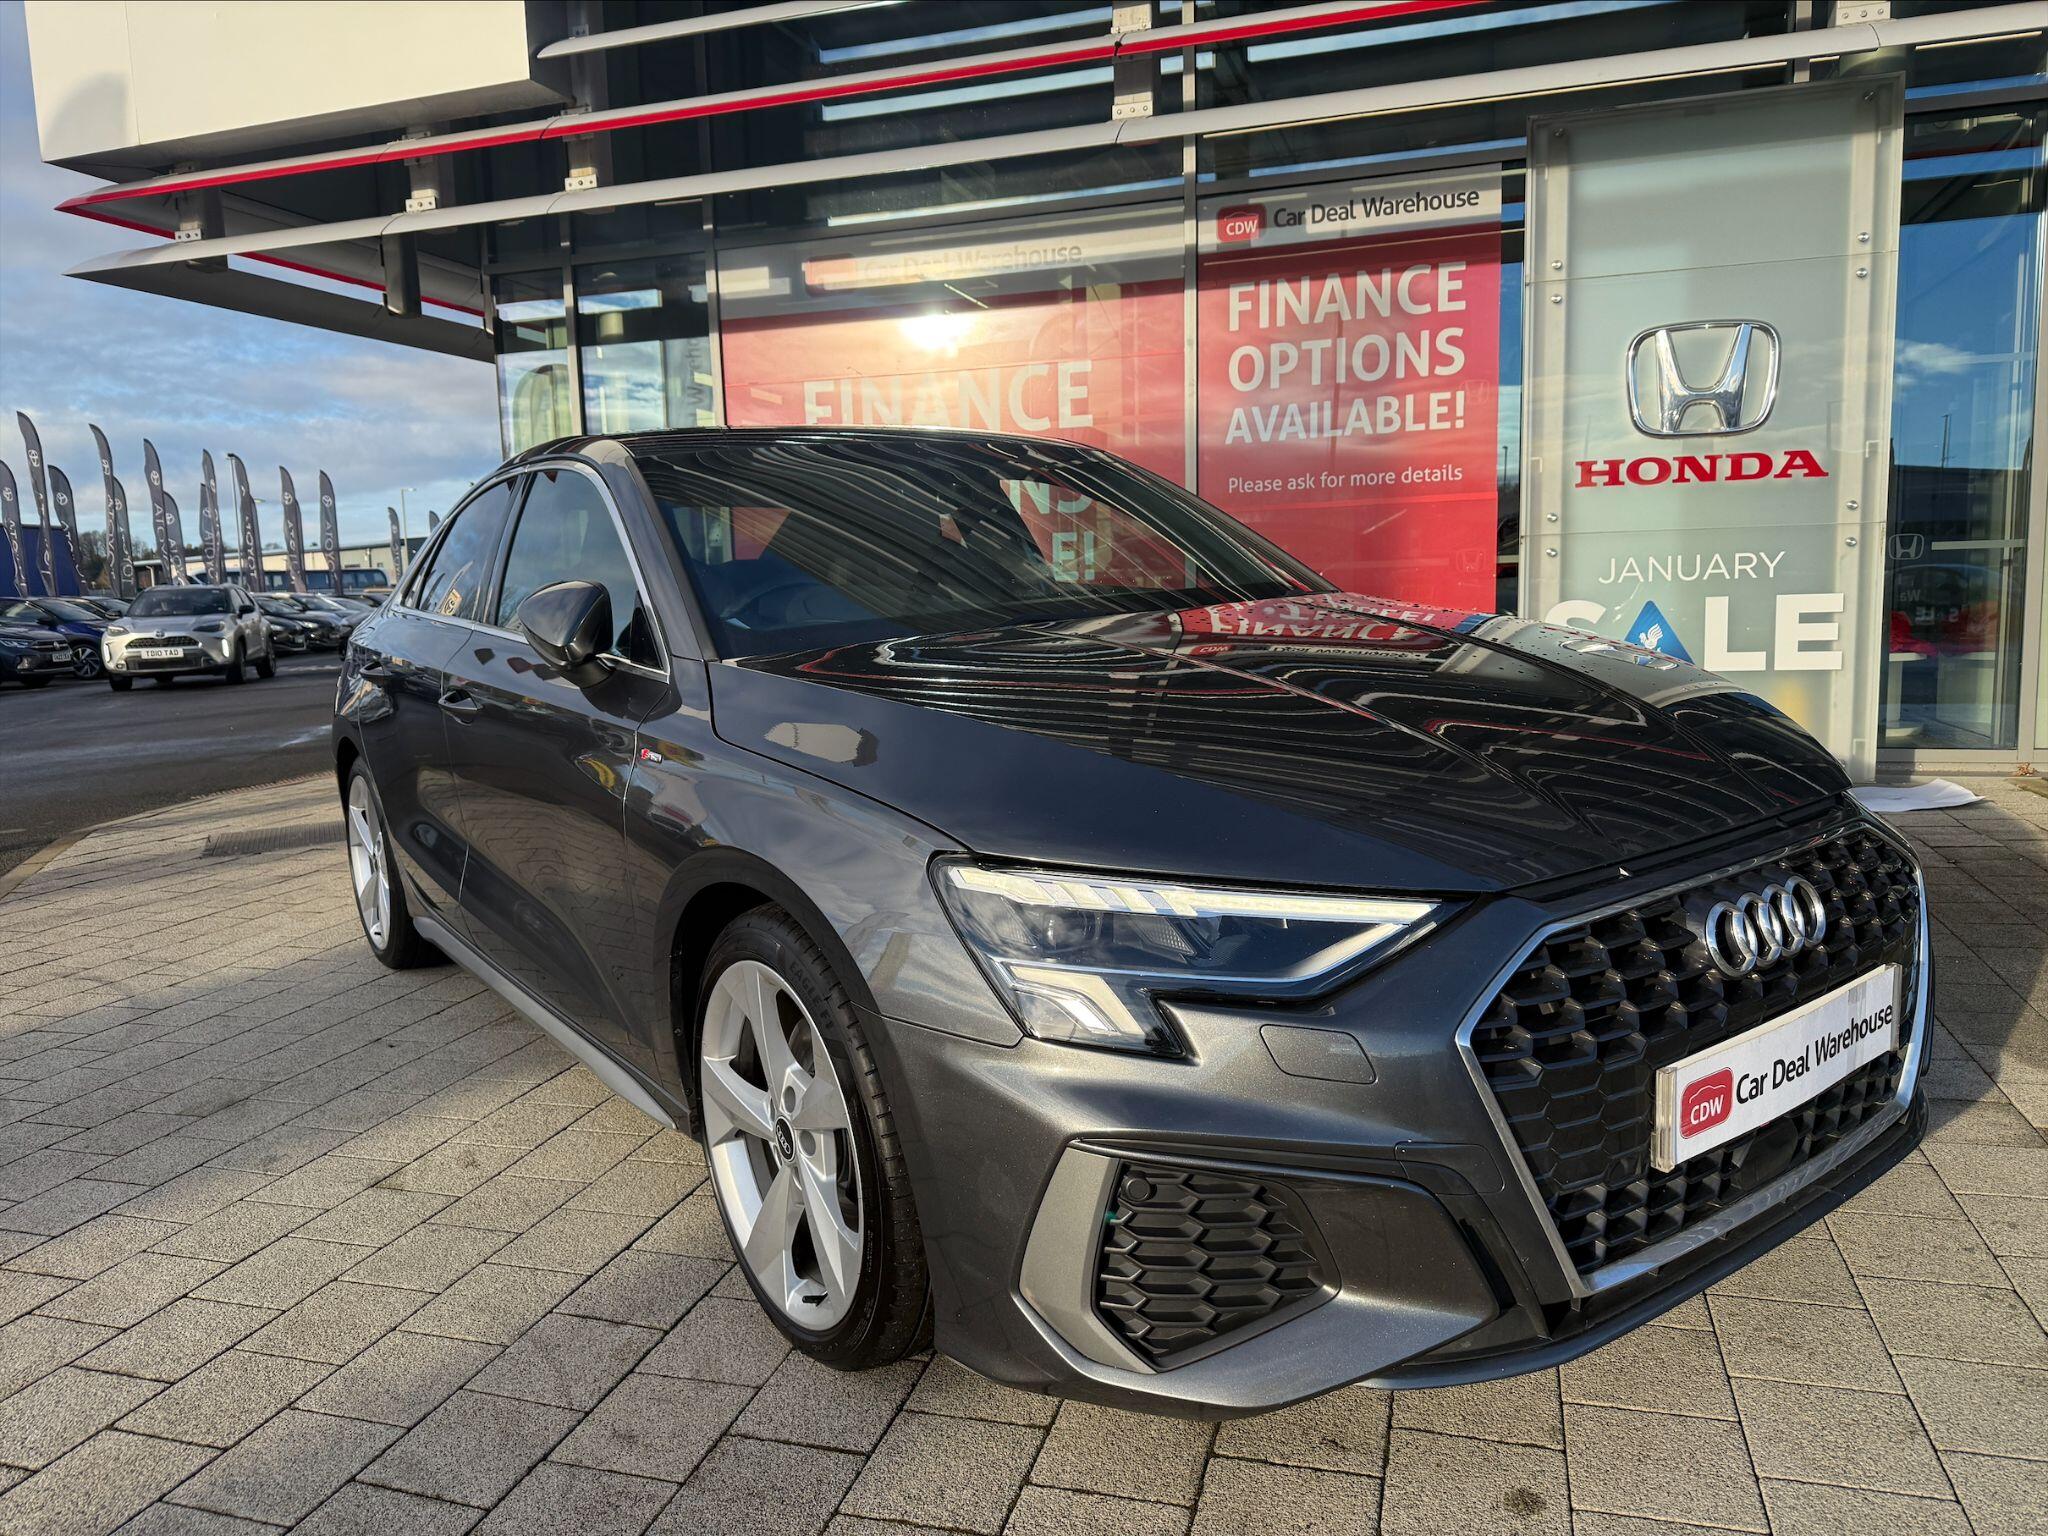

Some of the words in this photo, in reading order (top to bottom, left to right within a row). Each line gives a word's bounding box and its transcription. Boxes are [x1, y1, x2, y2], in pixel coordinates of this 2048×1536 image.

[1225, 218, 1258, 236] CDW
[1273, 207, 1306, 228] Car
[1311, 200, 1356, 224] Deal
[1362, 189, 1480, 219] Warehouse
[956, 243, 1083, 270] Warehouse
[1228, 261, 1467, 332] FINANCE
[1228, 327, 1465, 392] OPTIONS
[803, 359, 1094, 431] FINANCE
[1225, 391, 1466, 444] AVAILABLE!
[1228, 475, 1282, 494] Please
[1287, 472, 1315, 490] ask
[1320, 470, 1345, 489] for
[1350, 470, 1395, 487] more
[1401, 464, 1463, 484] details
[1575, 449, 1829, 489] HONDA
[1598, 551, 1786, 585] JANUARY
[1690, 1094, 1724, 1126] CDW
[1736, 1073, 1768, 1104] Car
[1772, 1045, 1811, 1090] Deal
[1815, 1004, 1894, 1068] Warehouse
